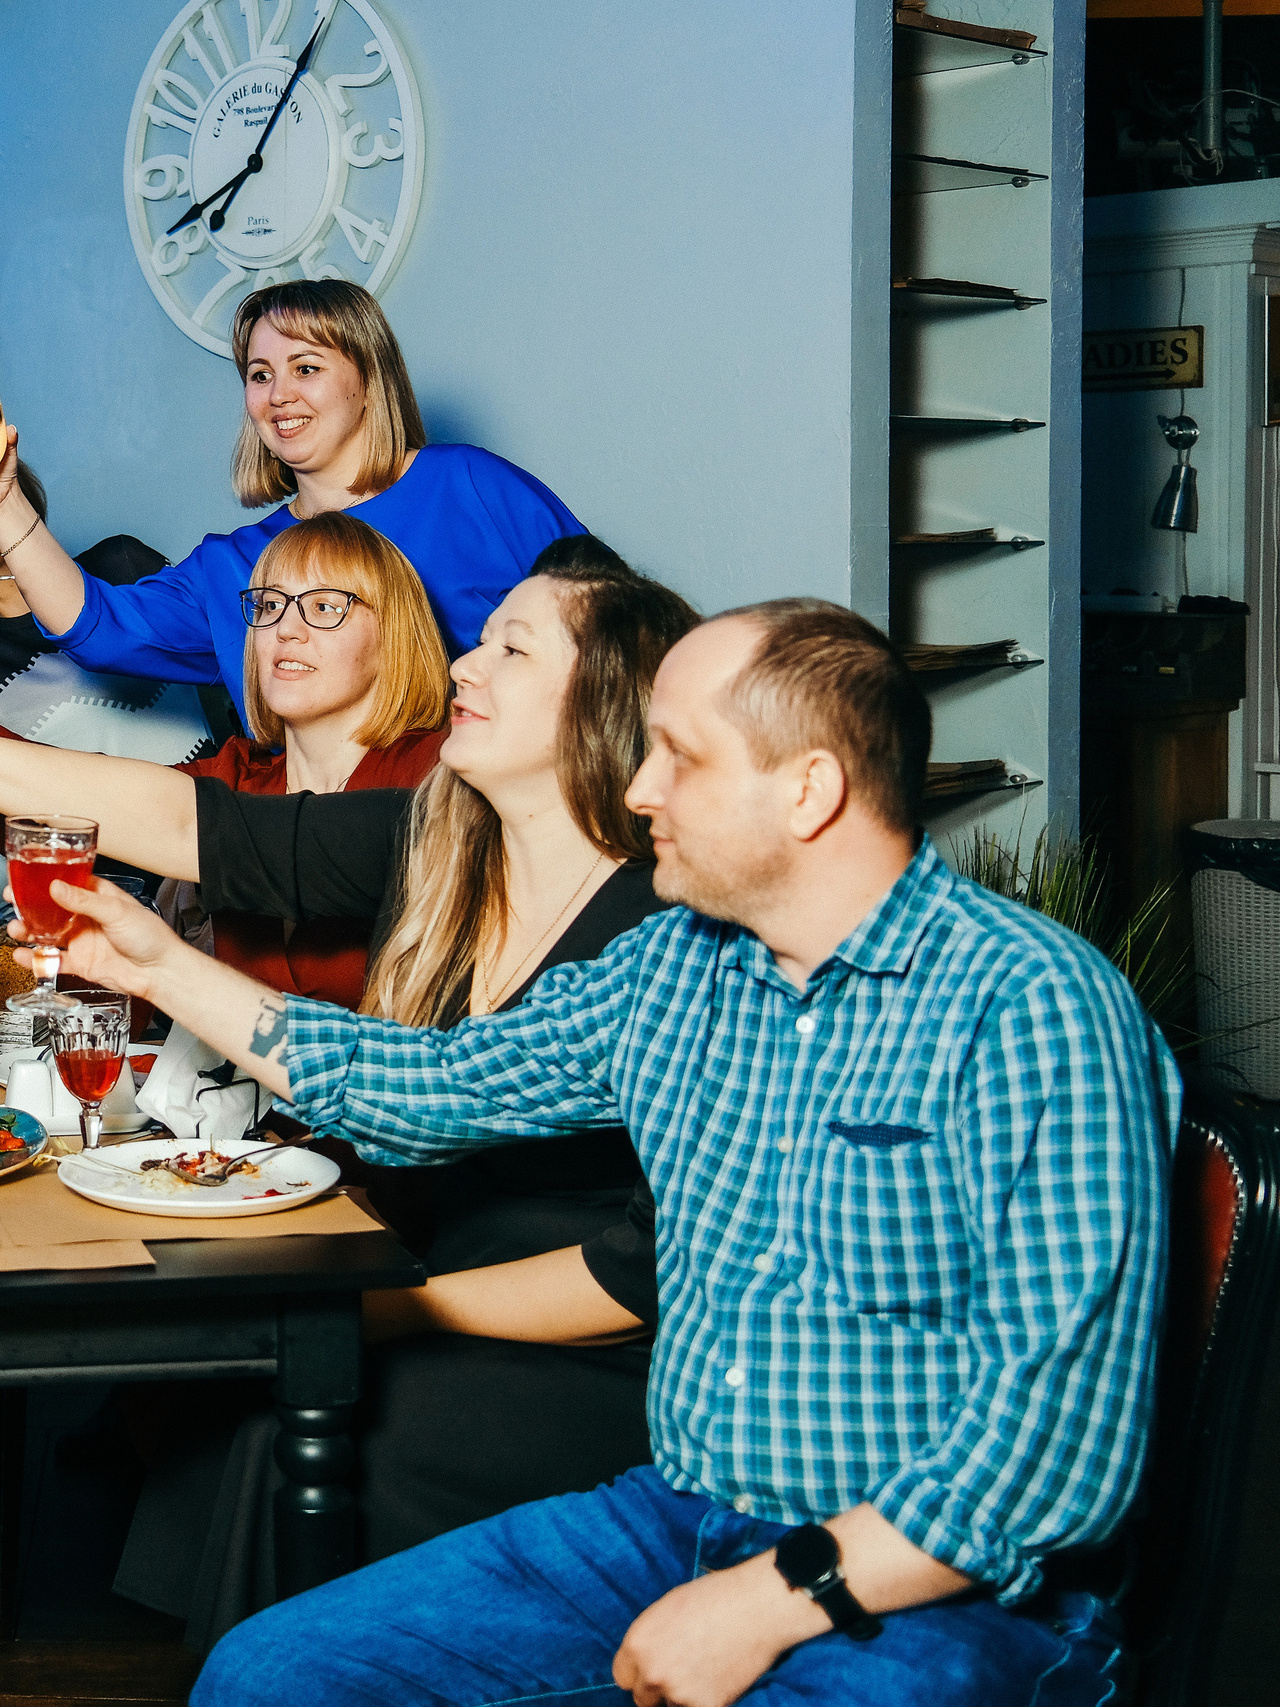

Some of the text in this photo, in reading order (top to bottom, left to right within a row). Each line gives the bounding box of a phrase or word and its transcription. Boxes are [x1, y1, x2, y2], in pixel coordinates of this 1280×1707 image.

[144, 69, 206, 135] 10
[324, 40, 391, 118] 2
[213, 84, 249, 138] GALERIE
[251, 83, 263, 94] du
[245, 103, 277, 115] Boulevar
[341, 118, 404, 169] 3
[137, 154, 191, 202] 9
[247, 216, 270, 226] Paris
[331, 203, 390, 264] 4
[151, 222, 210, 276] 8
[1082, 337, 1189, 369] ADIES
